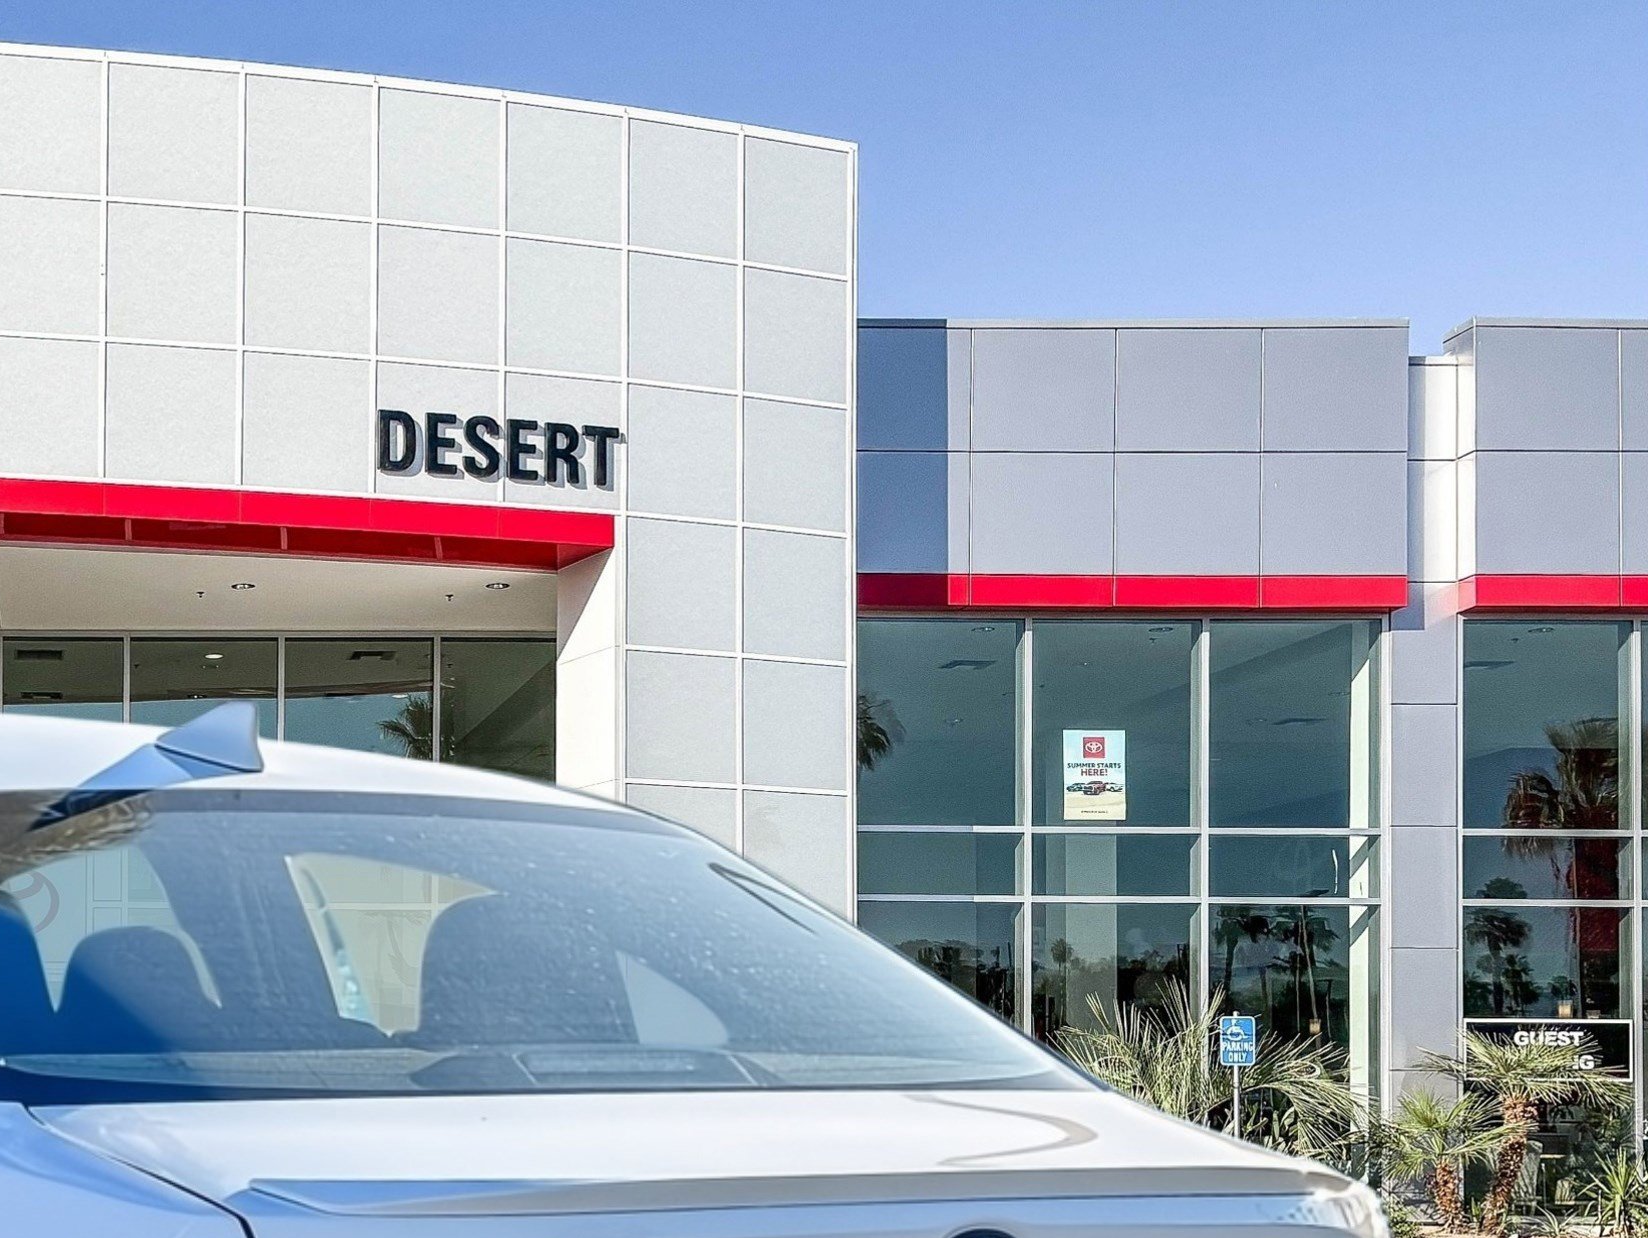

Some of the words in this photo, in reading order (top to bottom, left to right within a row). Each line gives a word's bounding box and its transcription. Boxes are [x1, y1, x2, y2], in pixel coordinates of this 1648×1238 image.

[377, 409, 620, 487] DESERT
[1080, 768, 1108, 776] HERE!
[1513, 1031, 1585, 1047] GUEST
[1222, 1041, 1254, 1052] PARKING
[1228, 1051, 1248, 1063] ONLY
